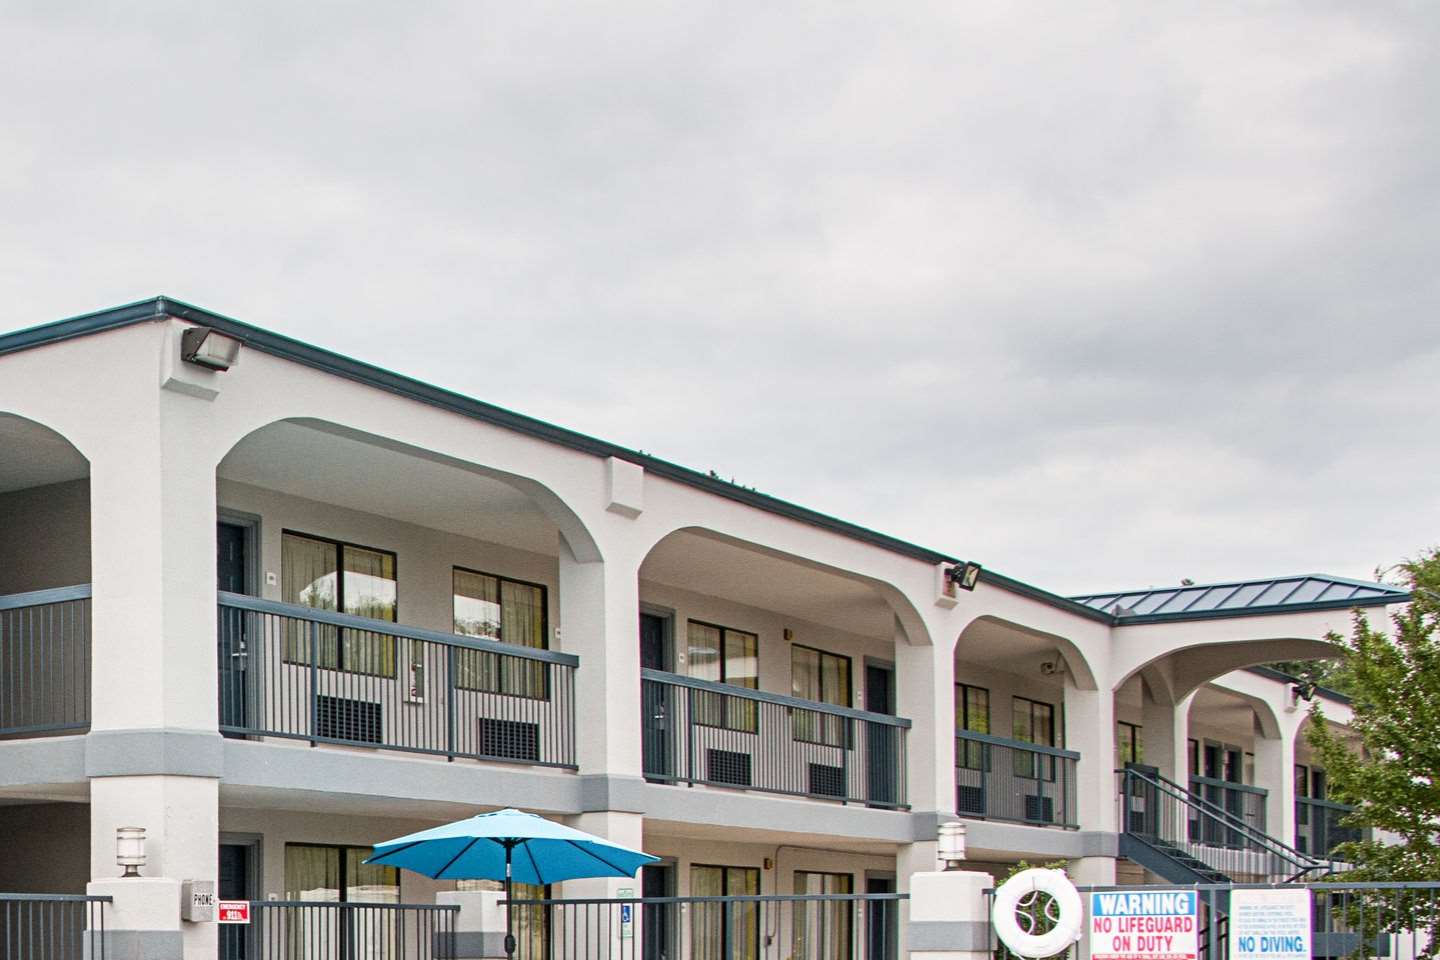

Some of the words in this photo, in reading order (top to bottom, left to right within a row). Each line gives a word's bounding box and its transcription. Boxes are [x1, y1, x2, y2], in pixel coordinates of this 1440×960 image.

[193, 893, 213, 906] PHONE
[1099, 893, 1189, 915] WARNING
[1093, 917, 1112, 933] NO
[1118, 916, 1193, 933] LIFEGUARD
[1112, 935, 1131, 951] ON
[1137, 935, 1173, 951] DUTY
[1238, 935, 1256, 952] NO
